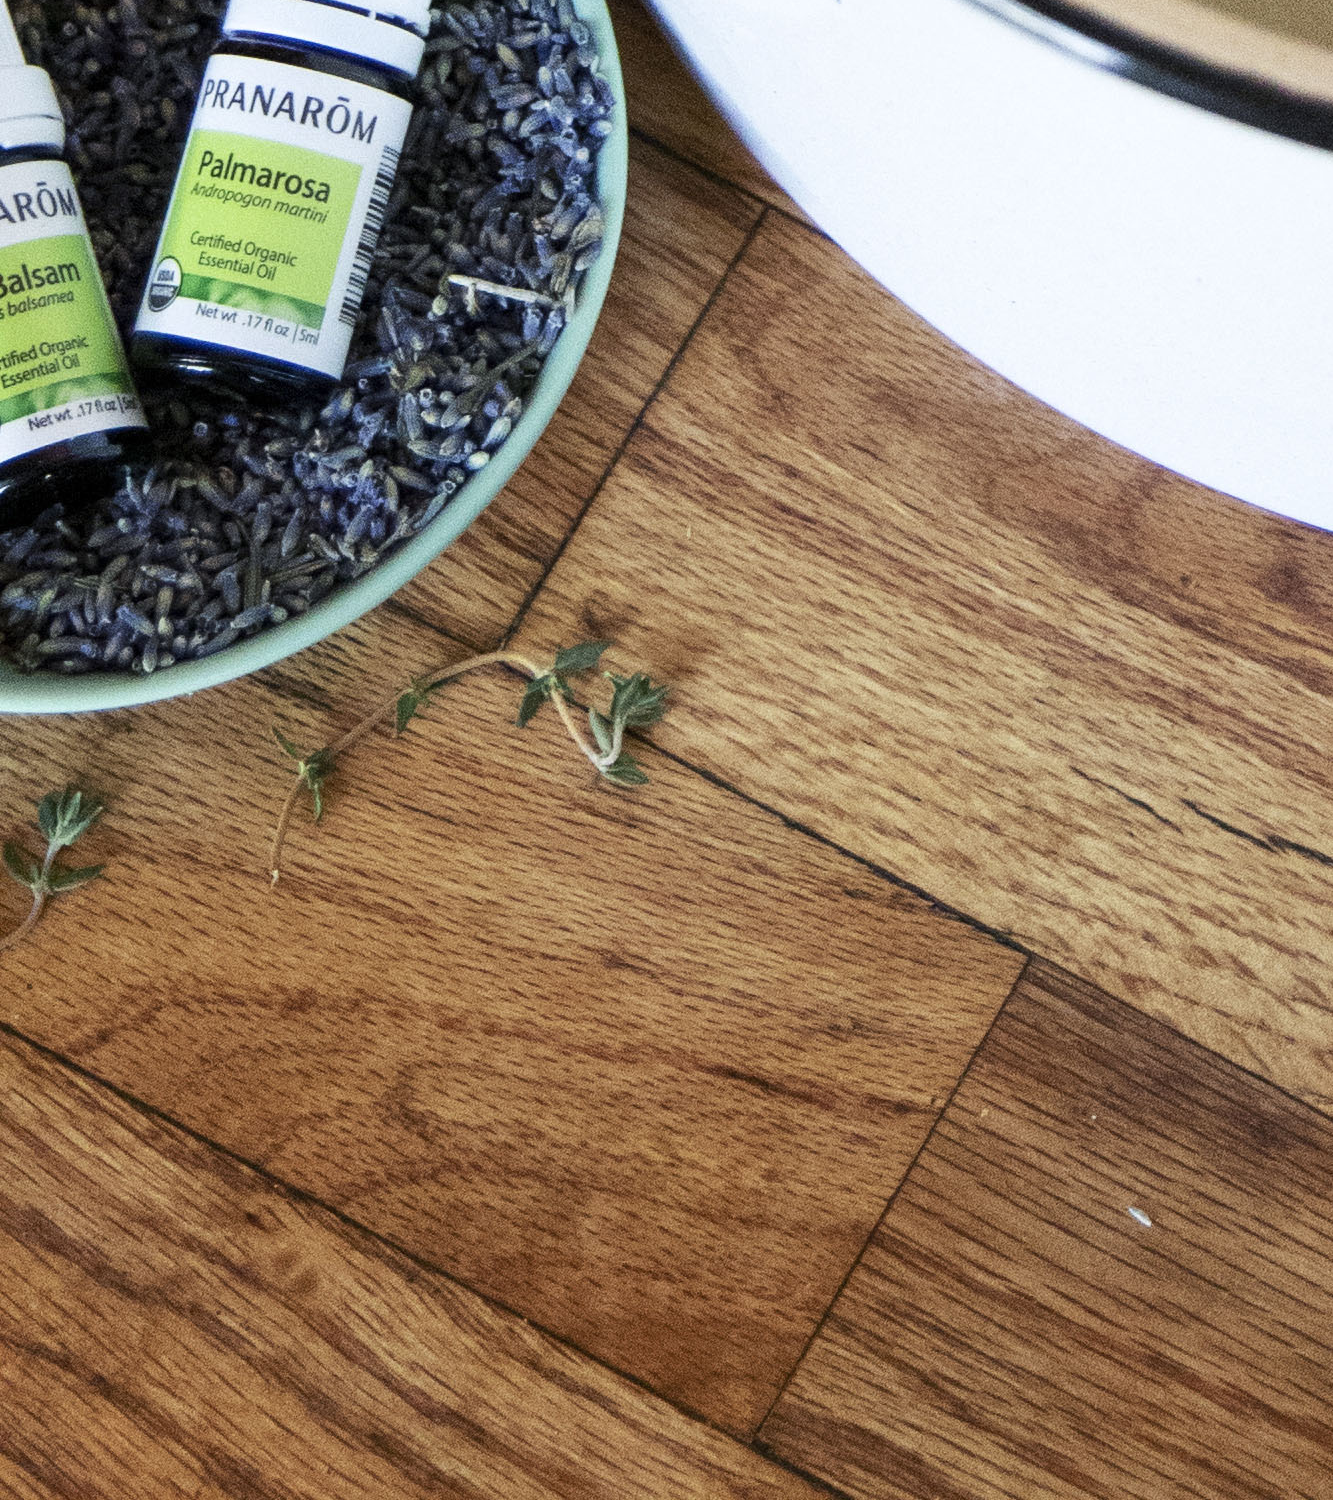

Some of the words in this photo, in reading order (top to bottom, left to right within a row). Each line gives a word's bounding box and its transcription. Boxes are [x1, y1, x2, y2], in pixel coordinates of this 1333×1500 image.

[201, 78, 377, 144] PRANARŌM
[198, 150, 330, 204] Palmarosa
[190, 183, 272, 209] Andropogon
[273, 201, 328, 224] martini
[190, 230, 242, 253] Certified
[244, 241, 298, 268] Organic
[198, 251, 255, 276] Essential
[256, 263, 277, 281] Oil
[7, 291, 74, 317] balsamea
[195, 303, 218, 320] Net
[220, 311, 239, 324] wt
[241, 314, 264, 330] .17
[263, 318, 274, 333] fl
[274, 324, 290, 338] oz
[39, 335, 89, 356] Organic
[0, 358, 60, 388] Essential
[62, 353, 80, 369] Oil
[28, 413, 54, 431] Net
[55, 408, 73, 421] wt
